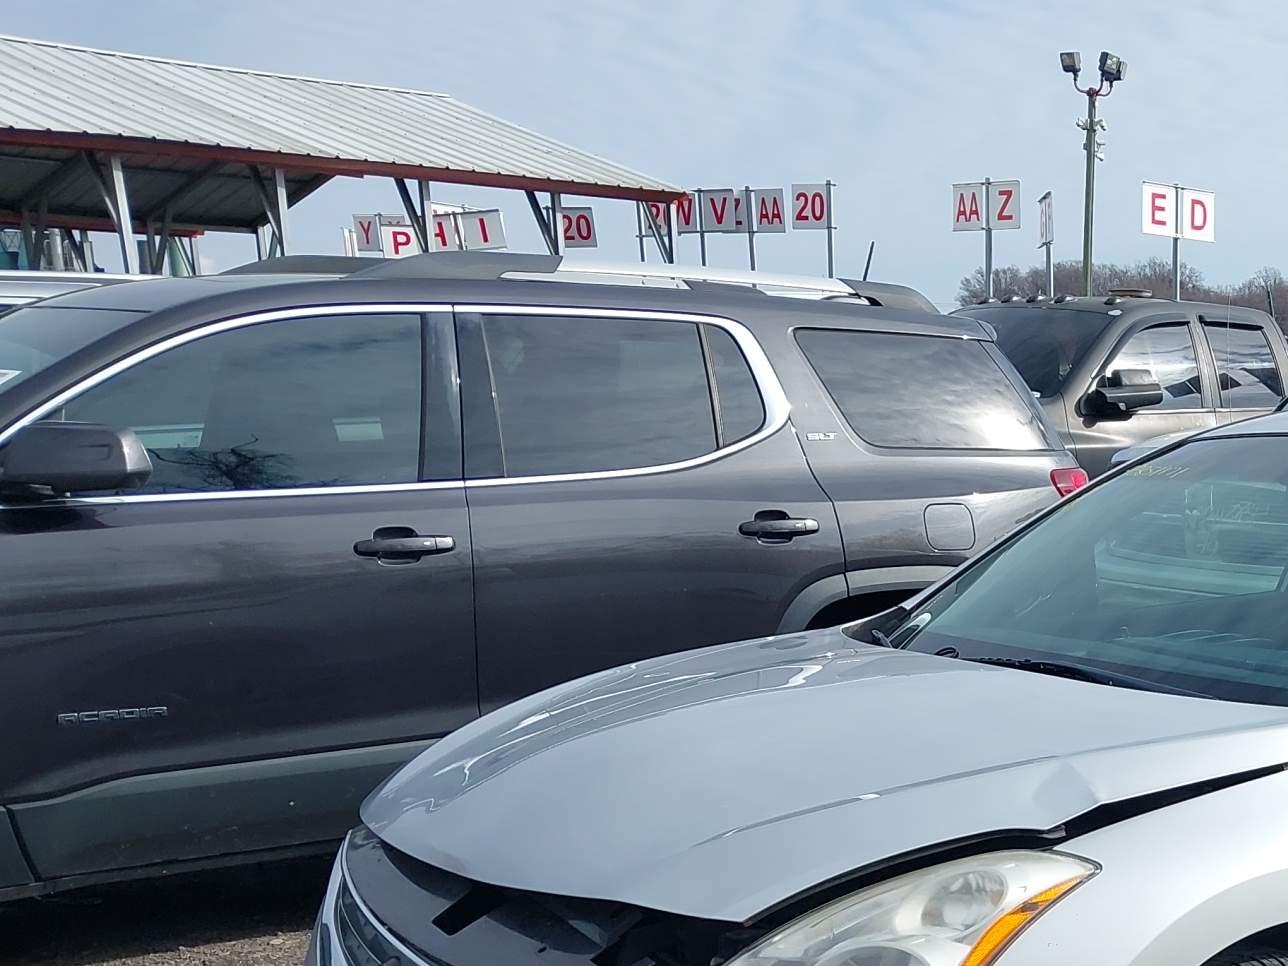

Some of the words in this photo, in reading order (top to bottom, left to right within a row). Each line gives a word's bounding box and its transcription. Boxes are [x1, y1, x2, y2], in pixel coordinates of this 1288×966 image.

[709, 197, 727, 225] V
[759, 196, 783, 225] AA
[795, 191, 825, 222] 20
[956, 191, 980, 222] AA
[997, 189, 1013, 221] Z
[1151, 192, 1167, 226] E
[1190, 198, 1207, 231] D
[359, 220, 371, 245] Y
[478, 217, 489, 243] I
[562, 213, 592, 241] 20
[392, 231, 411, 255] P
[57, 706, 168, 724] ACADIA
